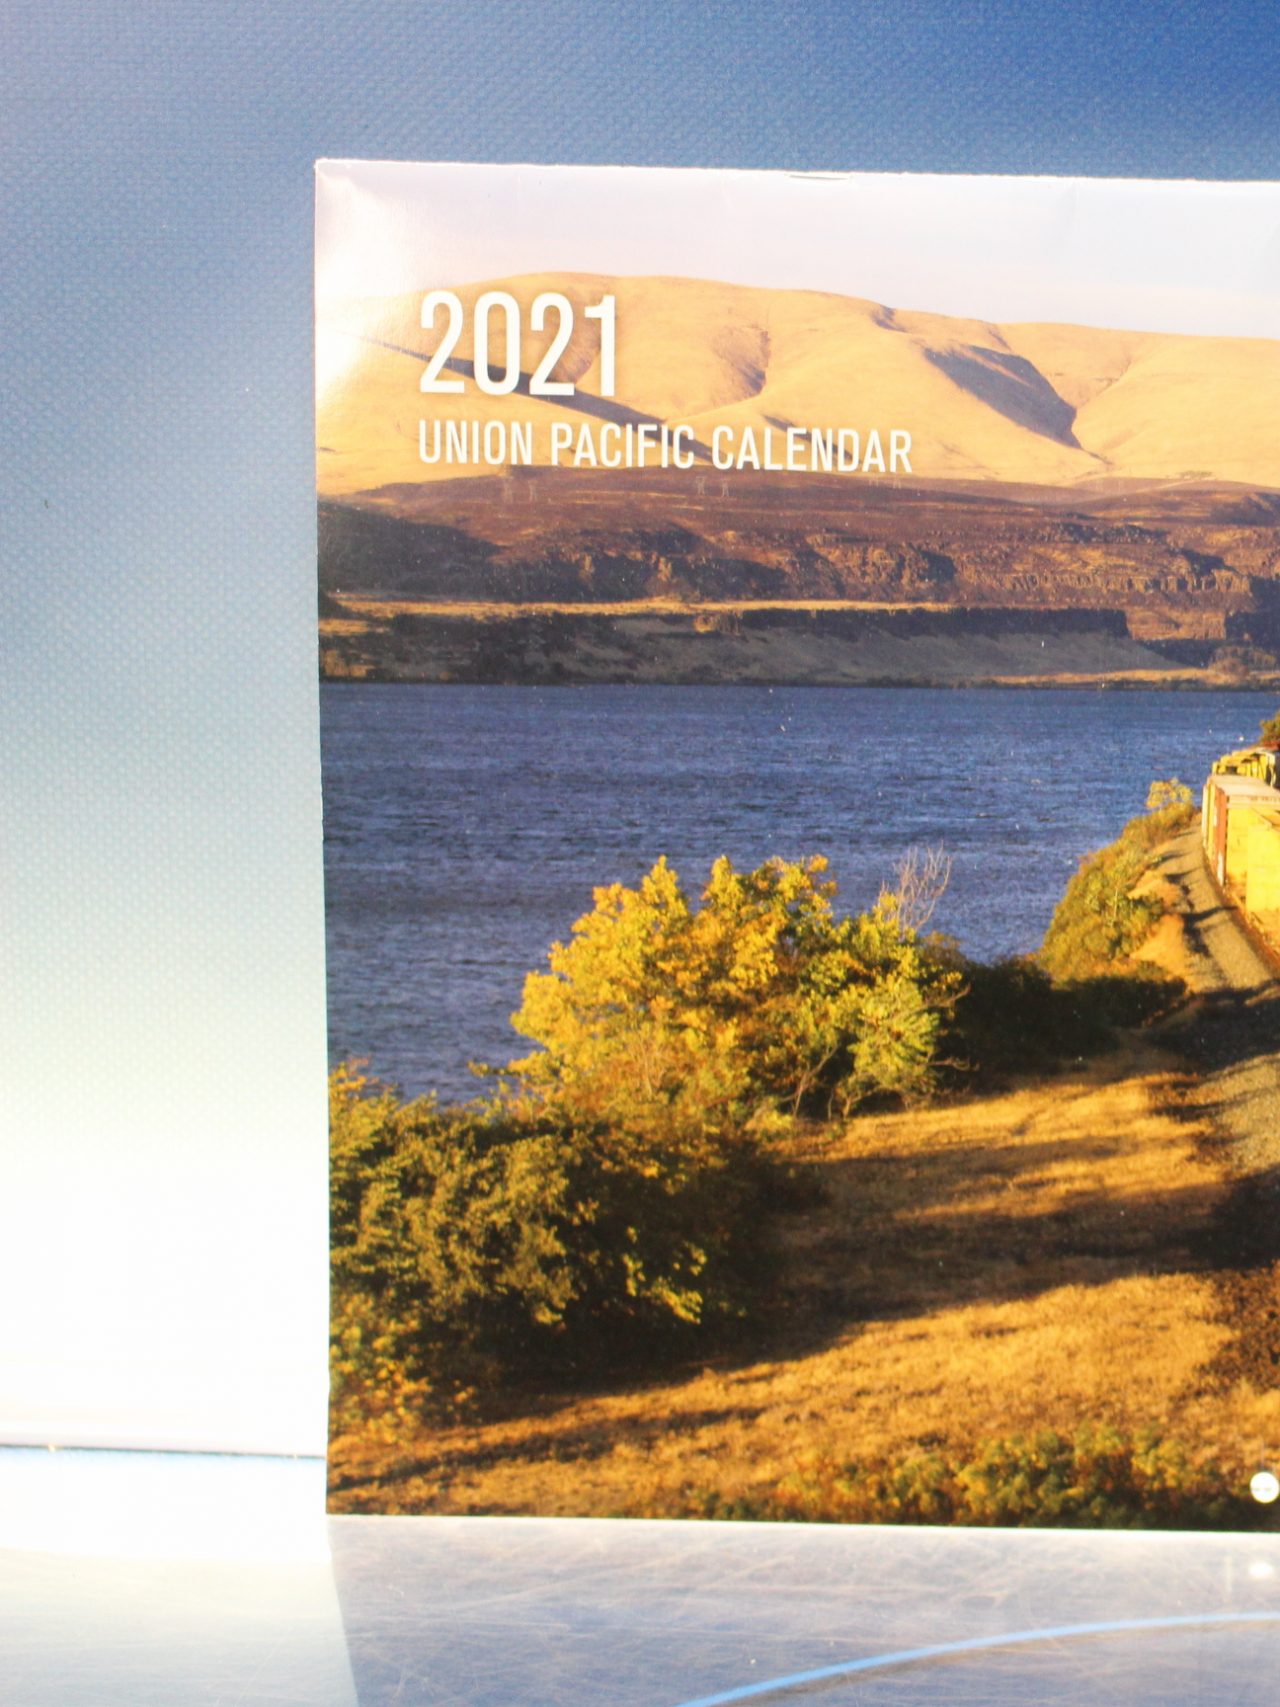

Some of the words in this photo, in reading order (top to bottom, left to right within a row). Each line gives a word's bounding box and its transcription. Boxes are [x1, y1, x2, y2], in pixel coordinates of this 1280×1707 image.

[419, 290, 617, 397] 2021
[418, 419, 533, 465] UNION
[550, 422, 695, 470] PACIFIC
[711, 425, 913, 473] CALENDAR
